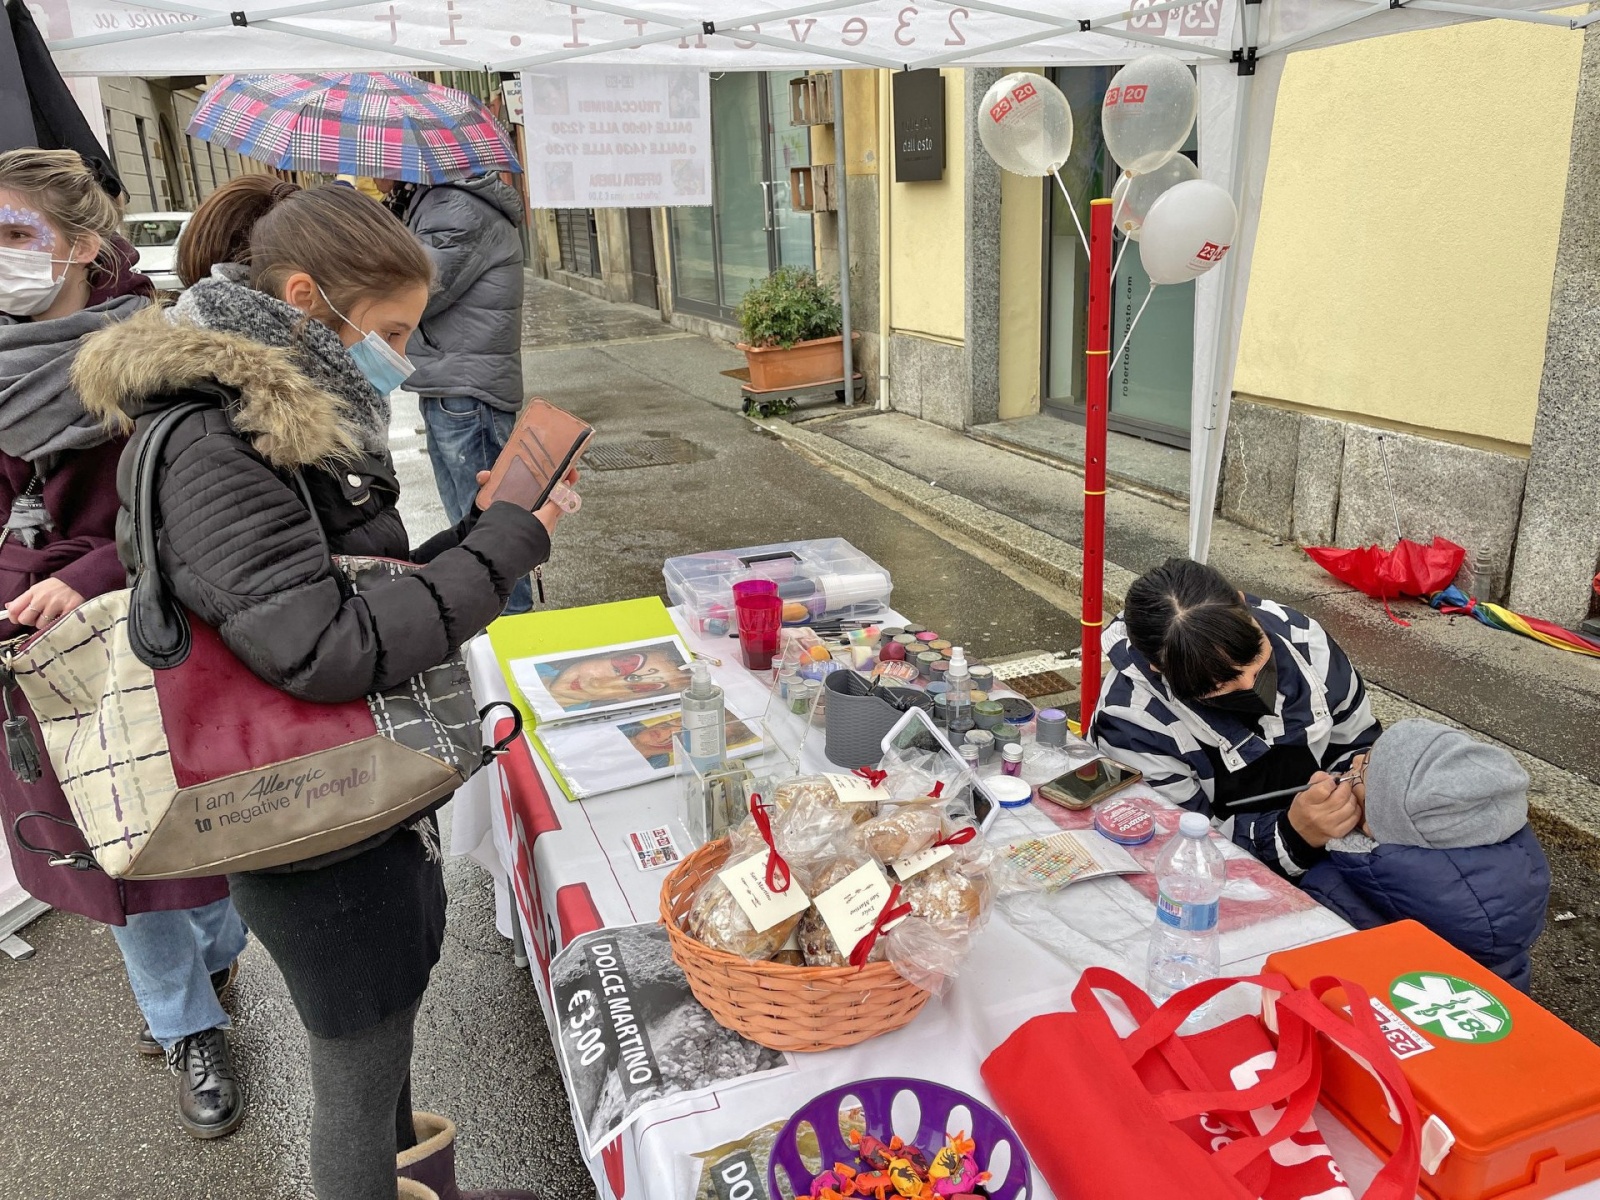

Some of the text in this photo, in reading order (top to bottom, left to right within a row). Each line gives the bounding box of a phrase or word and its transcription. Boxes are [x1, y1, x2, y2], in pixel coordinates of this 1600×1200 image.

[992, 100, 1010, 119] 23
[1015, 85, 1033, 100] 20
[1125, 88, 1145, 100] 20
[1121, 275, 1133, 397] robertodalosto.com
[194, 766, 327, 812] I am Allergic
[194, 816, 213, 834] to
[219, 795, 290, 827] negative
[590, 942, 653, 1086] DOLCE MARTINO
[1386, 1031, 1416, 1051] 23
[721, 1160, 754, 1200] DO
